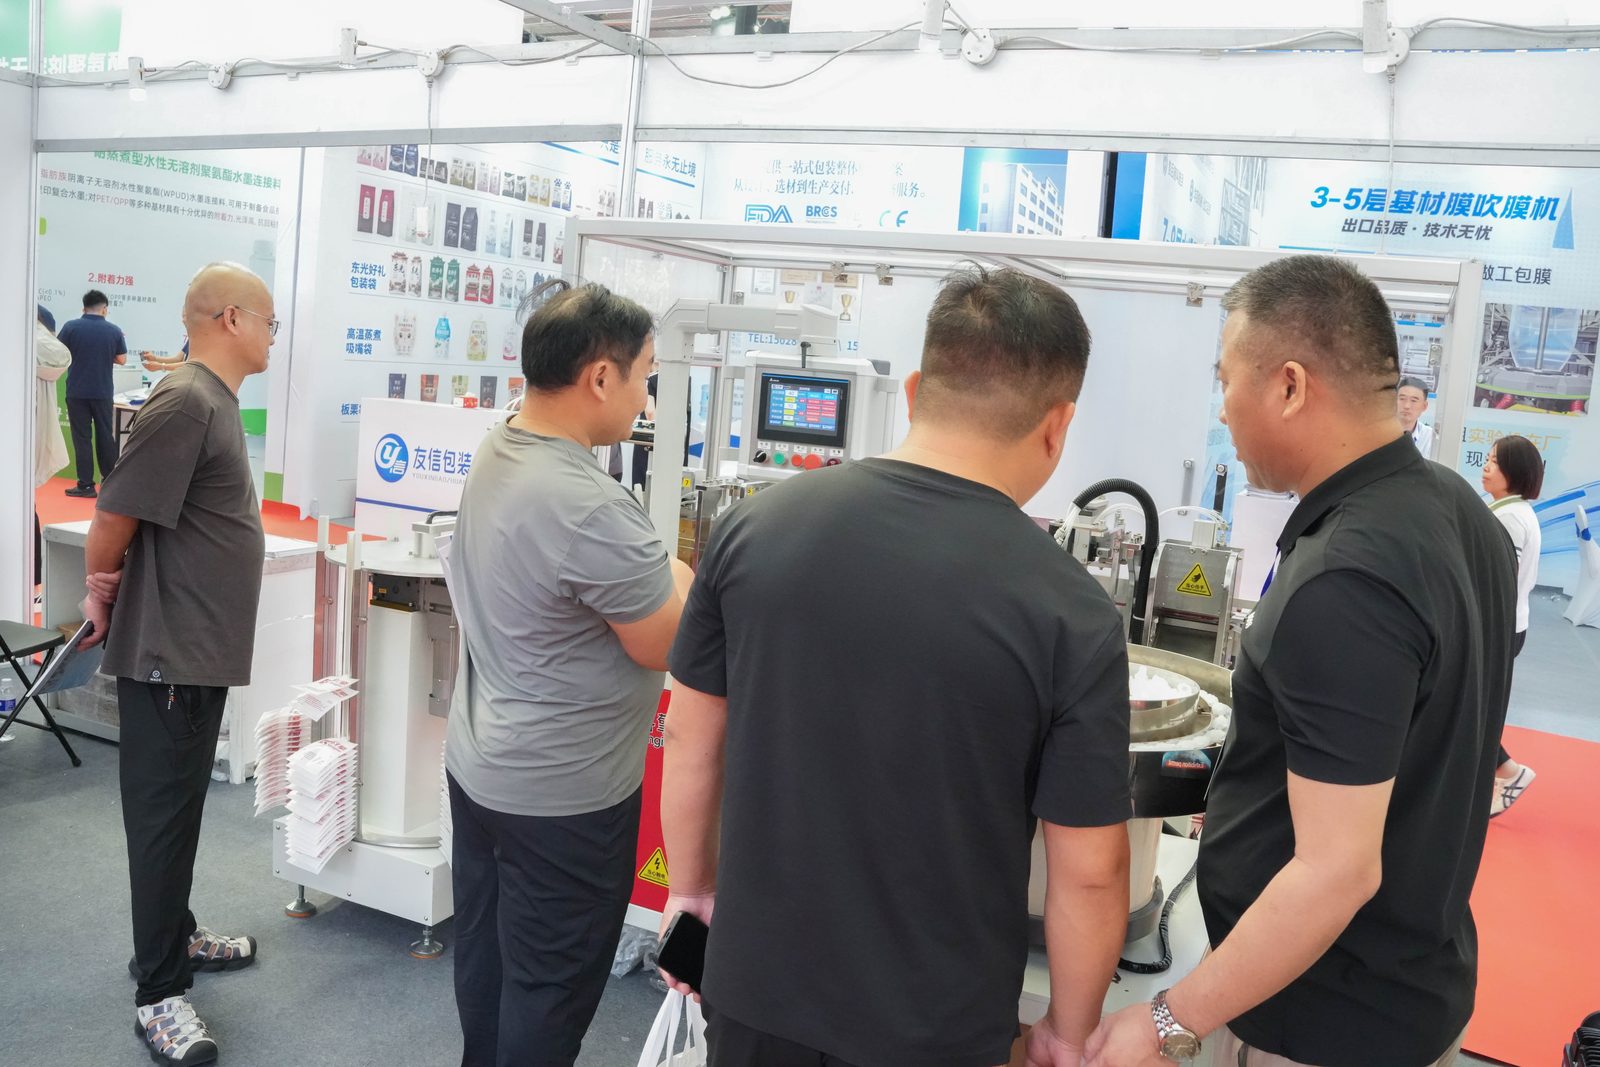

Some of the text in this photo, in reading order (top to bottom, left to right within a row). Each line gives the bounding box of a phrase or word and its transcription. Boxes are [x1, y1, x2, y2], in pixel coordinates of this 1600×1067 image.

[1310, 186, 1560, 221] 3-5层基材膜吹膜机
[744, 204, 793, 223] FDA
[351, 261, 386, 277] 东光好礼
[88, 272, 134, 286] 2.附着力强
[351, 276, 377, 290] 包装袋
[347, 328, 382, 341] 高温蒸煮
[346, 343, 372, 355] 吸嘴袋
[341, 403, 361, 415] 板栗
[413, 446, 472, 475] 友信包装
